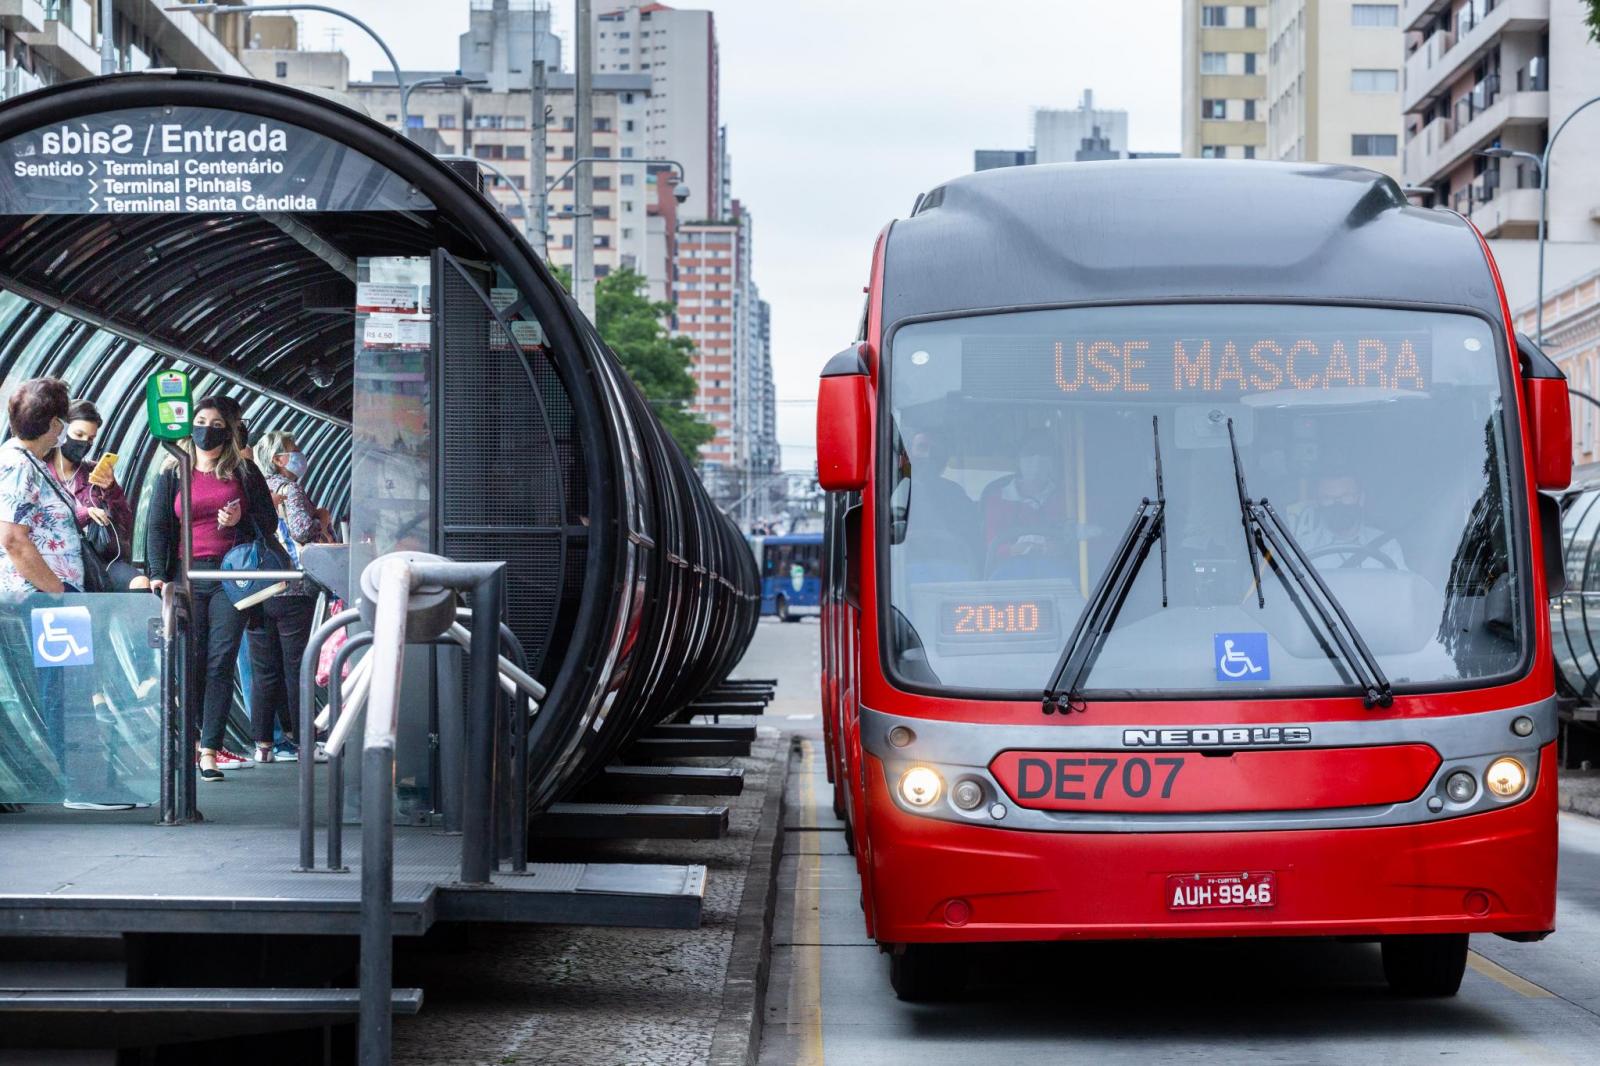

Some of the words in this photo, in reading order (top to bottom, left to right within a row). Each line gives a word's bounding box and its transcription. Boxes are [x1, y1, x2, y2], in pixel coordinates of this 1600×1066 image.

[143, 124, 154, 156] /
[161, 123, 287, 153] Entrada
[14, 161, 84, 177] Sentido
[103, 160, 179, 176] Terminal
[184, 158, 284, 175] Centenário
[103, 178, 180, 194] Terminal
[185, 177, 252, 193] Pinhais
[104, 196, 180, 212] Terminal
[185, 196, 237, 212] Santa
[242, 194, 317, 211] Cândida
[1055, 341, 1150, 392] USE
[1174, 339, 1424, 390] MASCARA
[955, 603, 1039, 633] 20:10
[1123, 728, 1311, 746] NEOBUS
[1017, 757, 1185, 800] DE707
